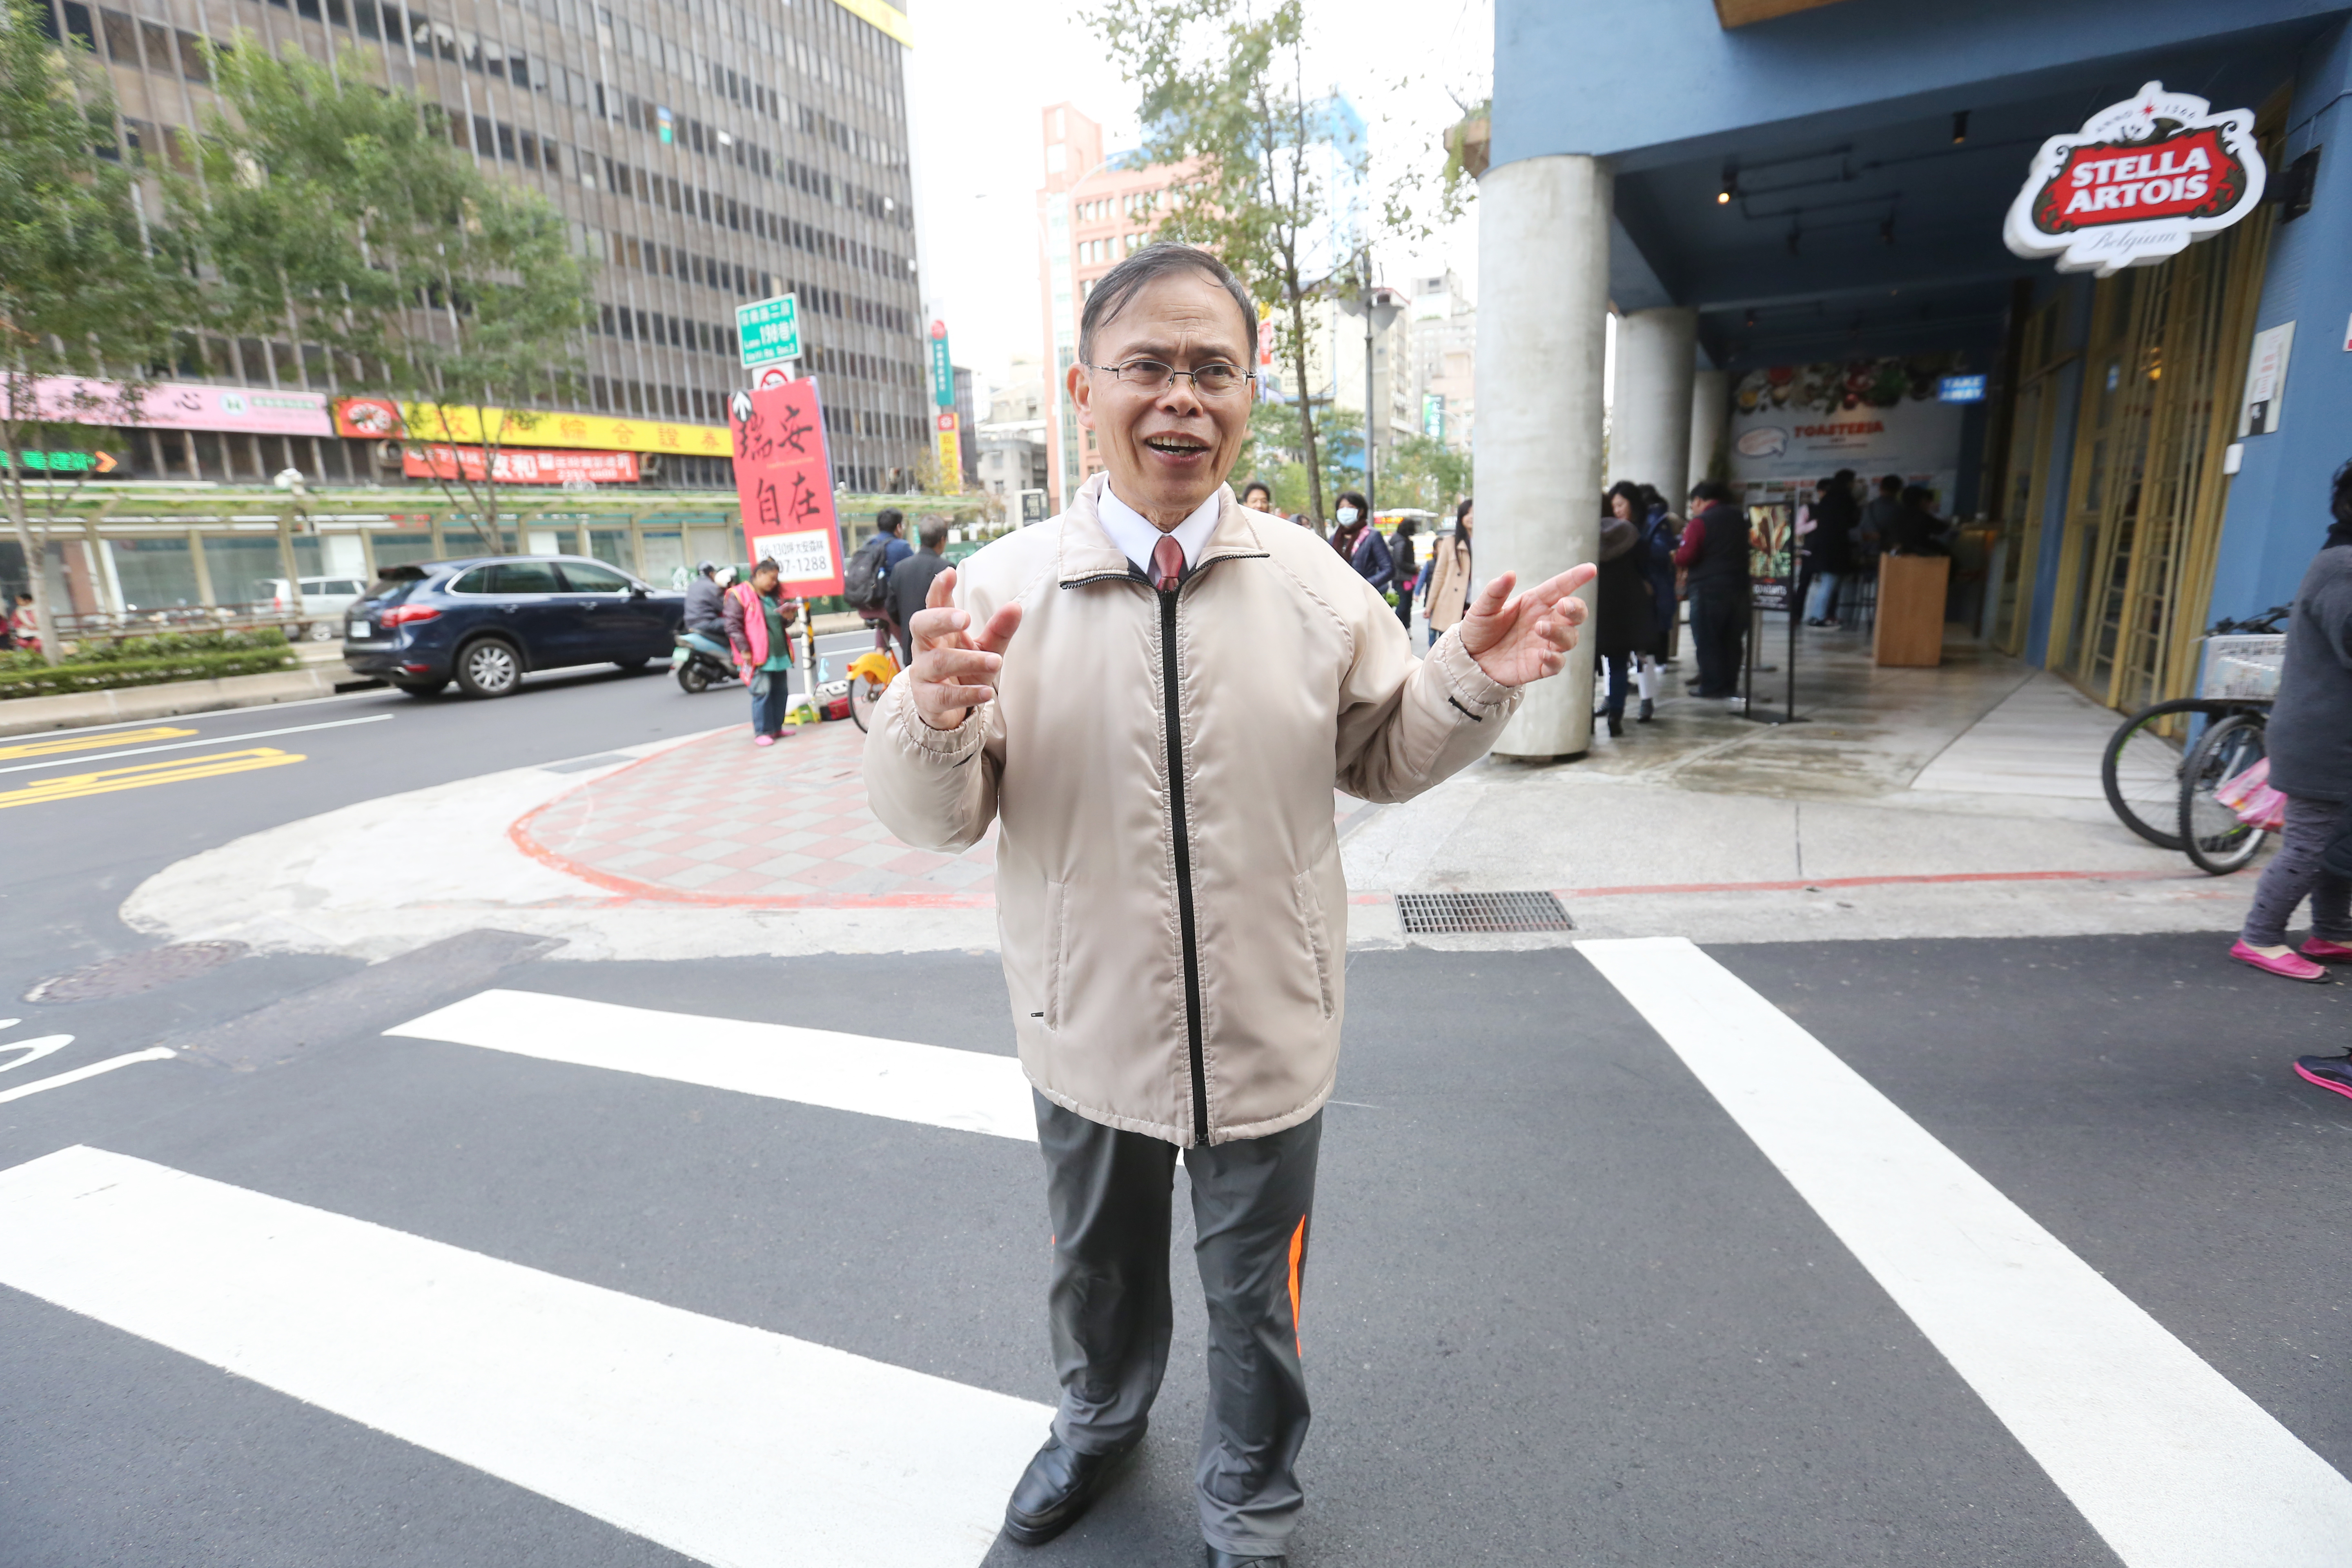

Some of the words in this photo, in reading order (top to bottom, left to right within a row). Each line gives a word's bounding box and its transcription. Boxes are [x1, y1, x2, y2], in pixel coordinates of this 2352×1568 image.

[2071, 147, 2211, 188] STELLA
[2064, 174, 2208, 215] ARTOIS
[2083, 229, 2179, 254] Belgium
